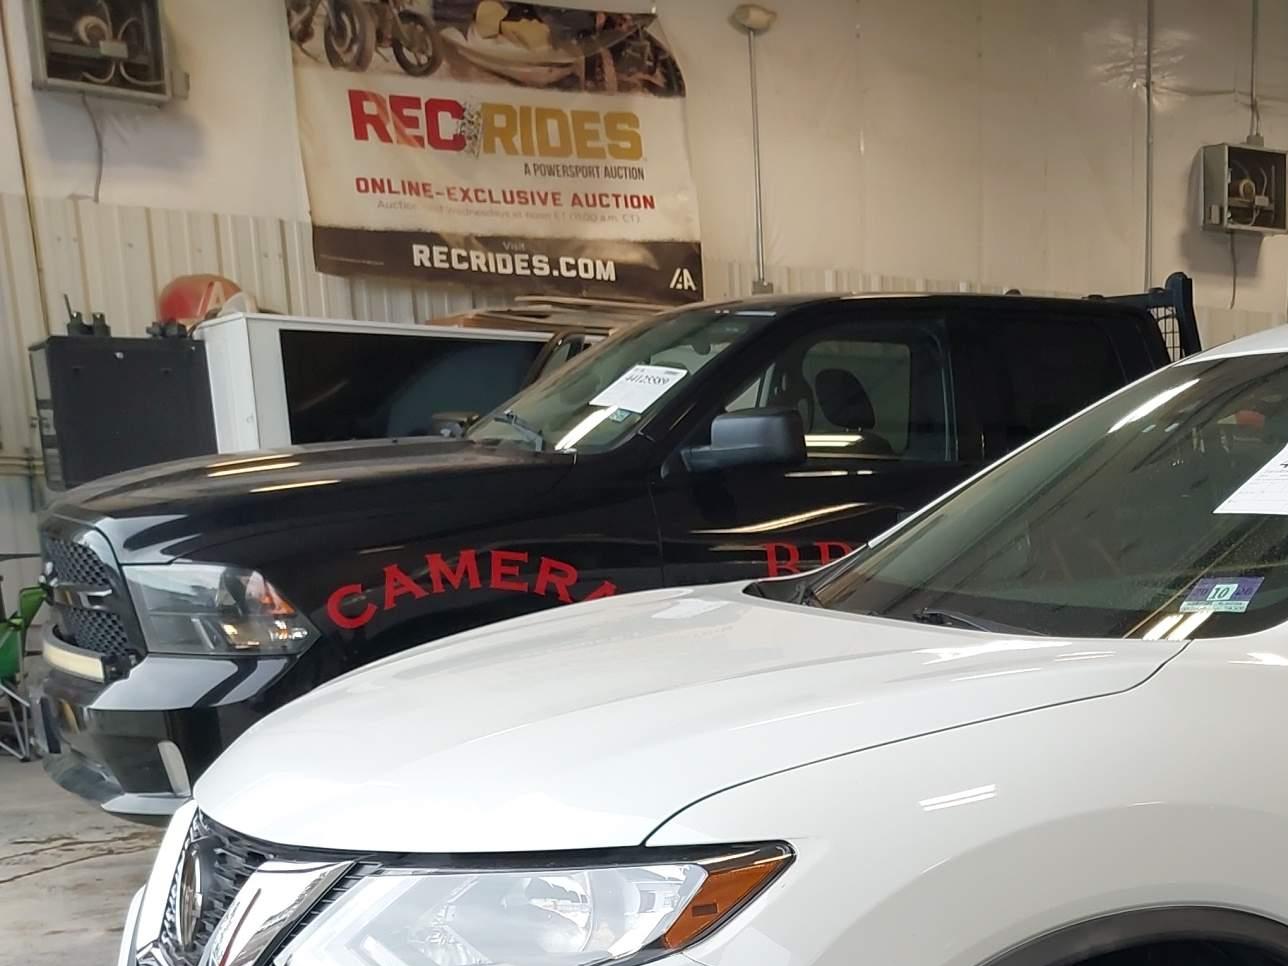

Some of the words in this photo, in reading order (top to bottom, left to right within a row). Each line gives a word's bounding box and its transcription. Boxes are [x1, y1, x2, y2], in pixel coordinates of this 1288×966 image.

[348, 89, 466, 151] REC
[481, 102, 643, 161] RIDES
[524, 163, 532, 176] A
[533, 164, 600, 179] POWERSPORT
[604, 166, 645, 181] AUCTION
[355, 177, 562, 206] ONLINE-EXCLUSIVE
[571, 192, 656, 210] AUCTION
[412, 244, 616, 281] RECRIDES.COM
[1209, 587, 1231, 599] 10
